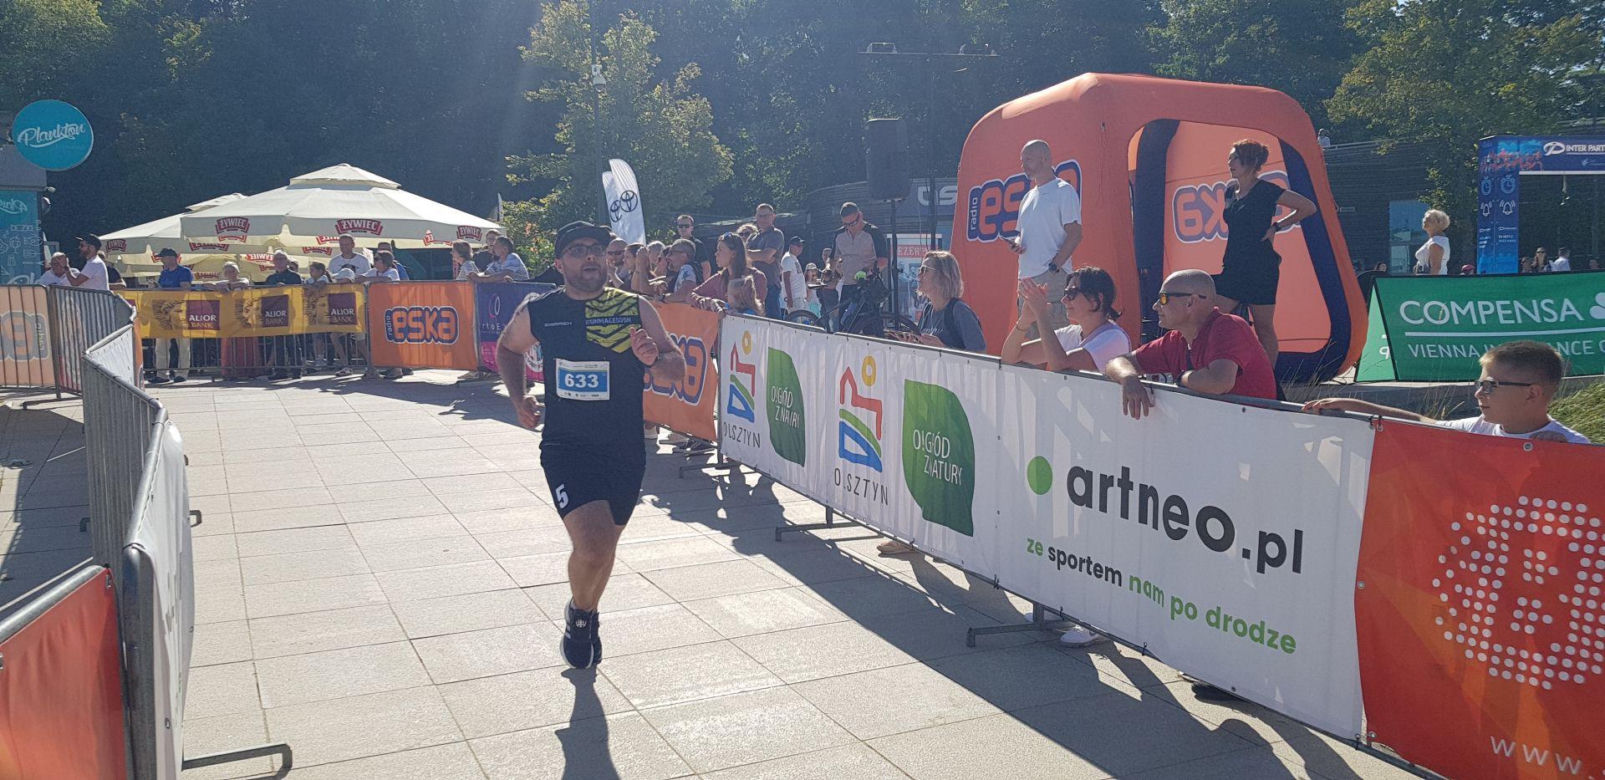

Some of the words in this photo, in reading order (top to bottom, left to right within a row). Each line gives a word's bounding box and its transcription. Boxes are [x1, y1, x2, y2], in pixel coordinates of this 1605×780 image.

[18, 122, 86, 148] Plankton
[969, 196, 978, 231] radio
[189, 314, 216, 322] ALIOR
[330, 308, 354, 316] ALIOR
[1400, 298, 1584, 325] COMPENSA
[1408, 343, 1481, 358] VIENNA
[565, 373, 599, 388] 633
[555, 484, 569, 509] 5
[834, 467, 889, 506] OSZTYN
[1067, 465, 1304, 575] artneo.pl
[1026, 537, 1044, 557] ze
[1048, 545, 1122, 587] sportem
[1129, 573, 1164, 608] nam
[1170, 593, 1198, 621] po
[1205, 606, 1297, 655] drodze
